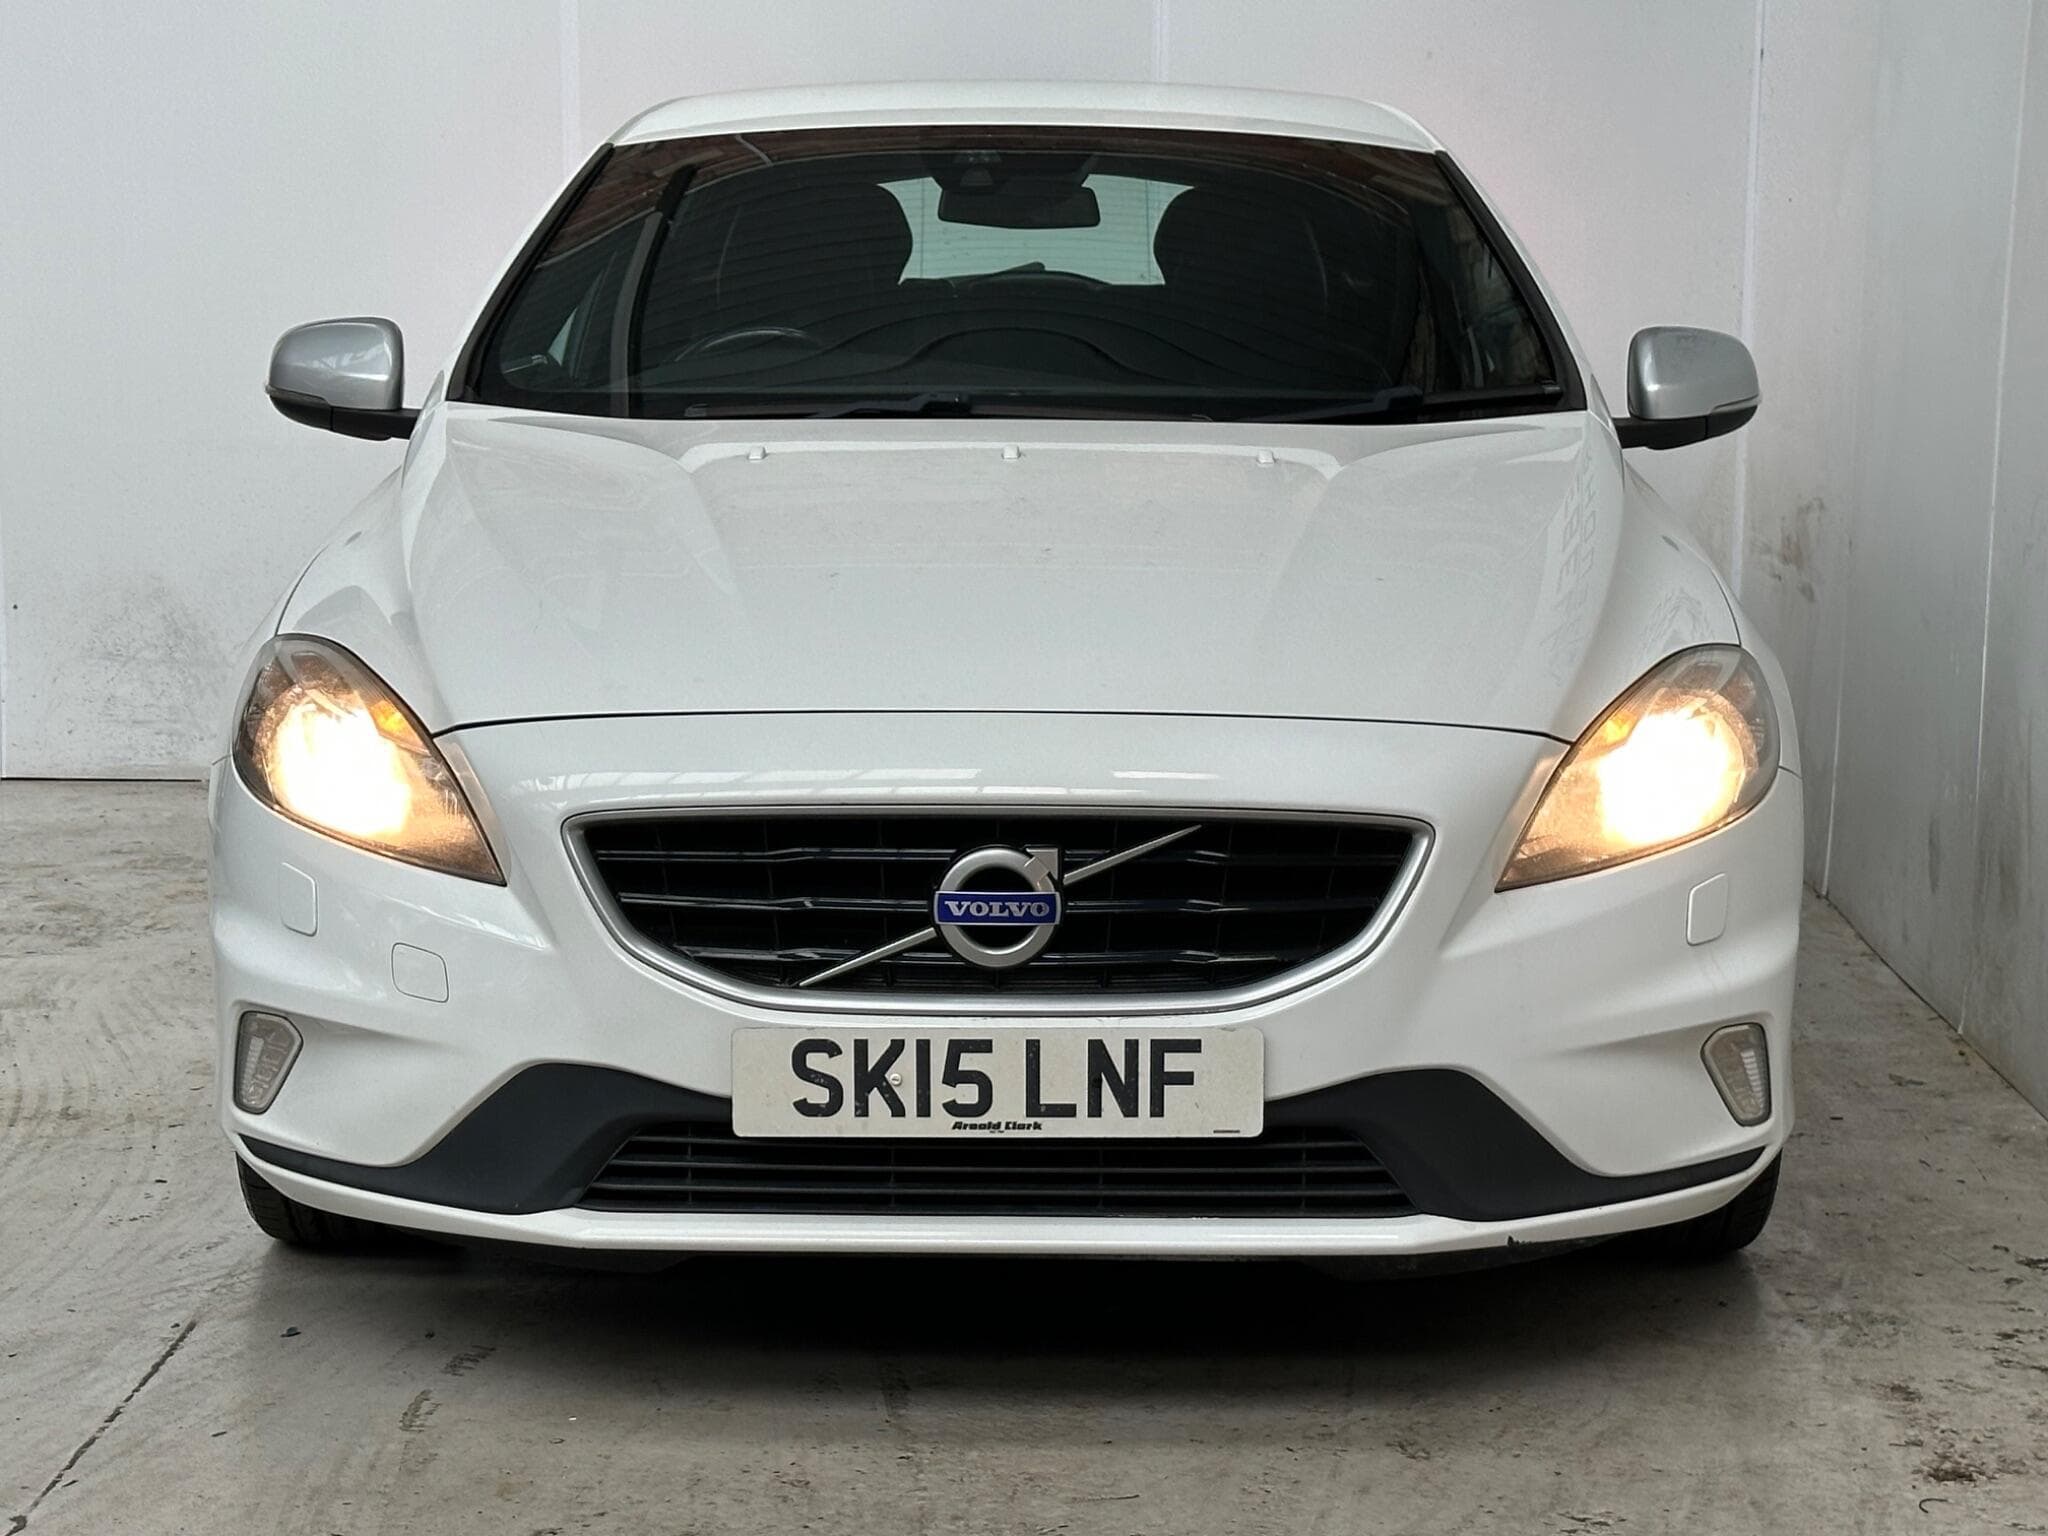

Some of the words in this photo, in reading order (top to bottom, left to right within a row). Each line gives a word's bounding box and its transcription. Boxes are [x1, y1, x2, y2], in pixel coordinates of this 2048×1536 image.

[944, 901, 1050, 917] VOLVO
[791, 1038, 994, 1118] SK15
[1025, 1038, 1202, 1118] LNF
[951, 1121, 1002, 1131] Arnold
[1004, 1121, 1043, 1131] Clark
